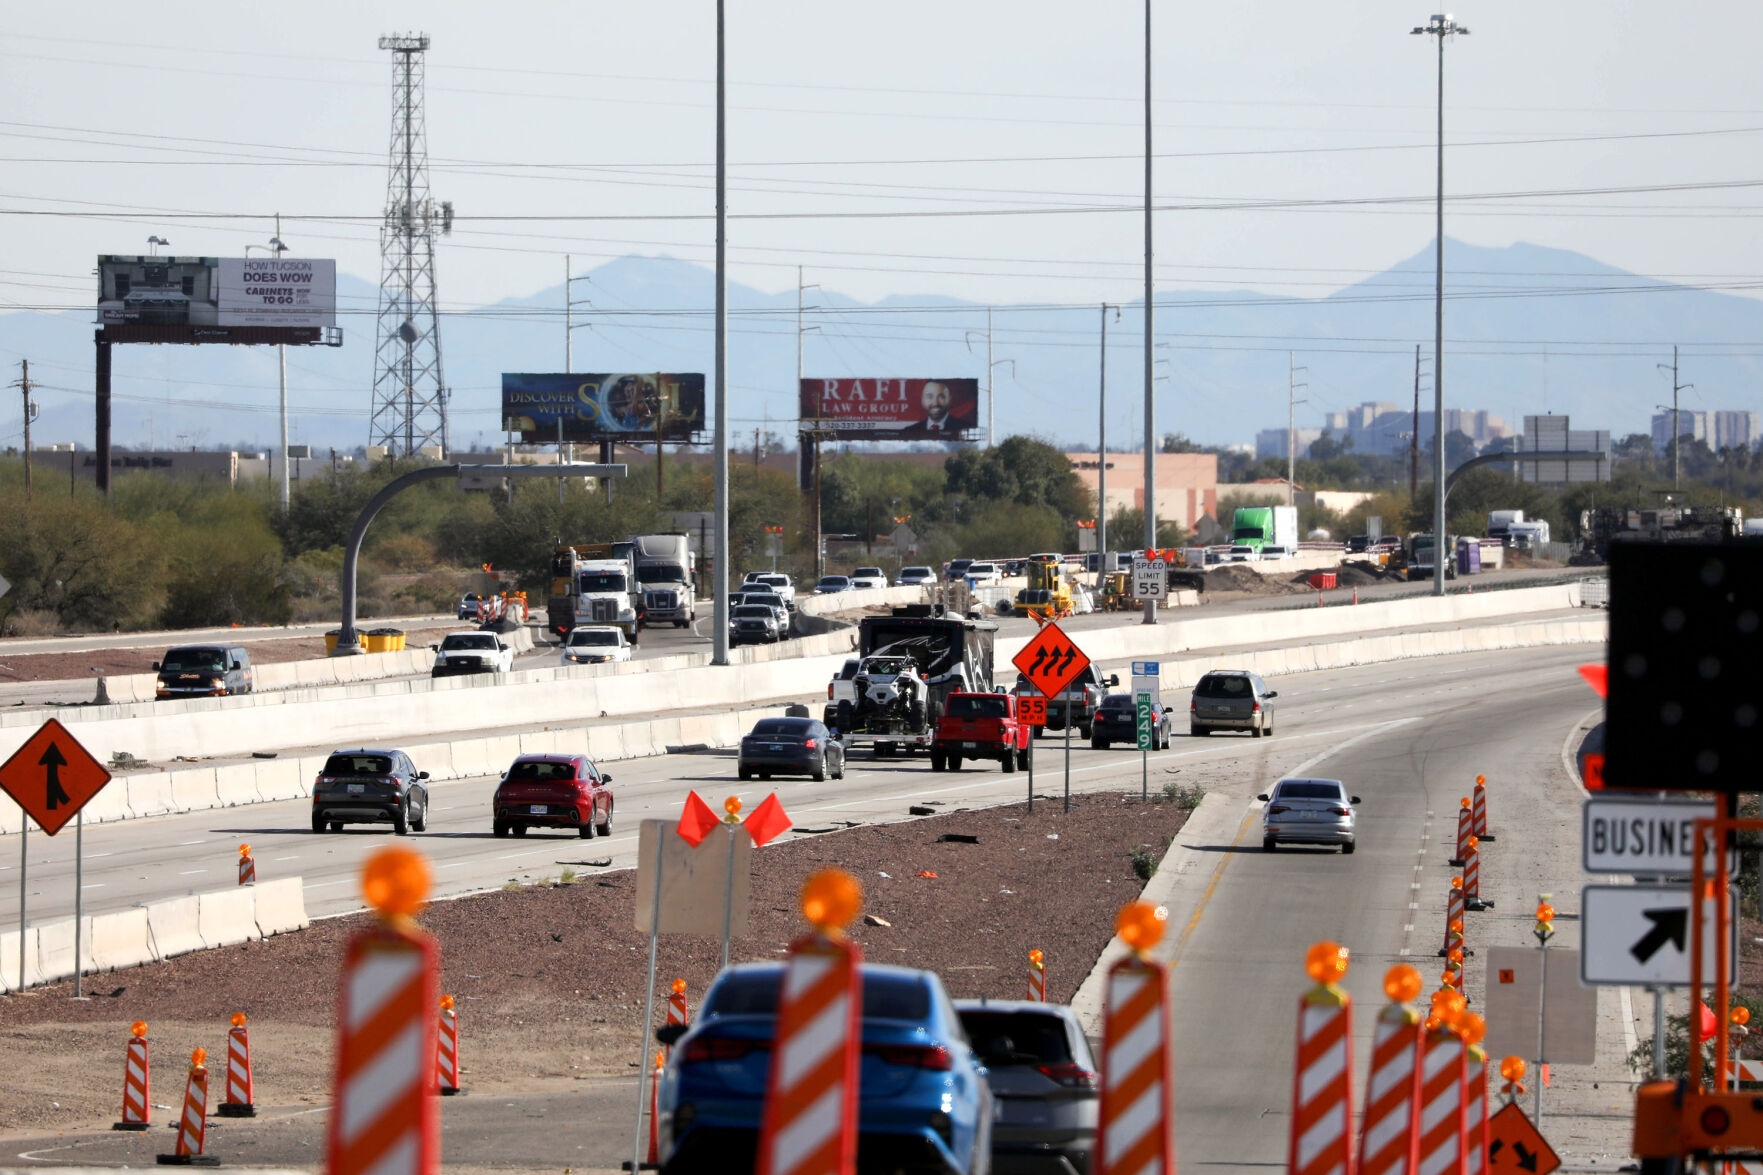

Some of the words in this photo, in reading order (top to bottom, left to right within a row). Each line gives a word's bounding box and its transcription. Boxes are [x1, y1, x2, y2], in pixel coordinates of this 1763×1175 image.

[244, 262, 268, 270] HOW
[271, 262, 312, 270] TUCSON
[244, 272, 277, 282] DOES
[280, 272, 312, 282] WOW
[246, 288, 293, 296] CABINETS
[263, 296, 275, 304] TO
[278, 296, 293, 304] GO
[823, 379, 908, 401] RAFI
[510, 392, 575, 402] DISCOVER
[539, 404, 574, 414] WITH
[822, 403, 851, 412] LAW
[858, 403, 908, 412] GROUP
[1139, 582, 1160, 594] 55
[1020, 700, 1044, 713] 55
[1592, 818, 1714, 856] BUSINE
